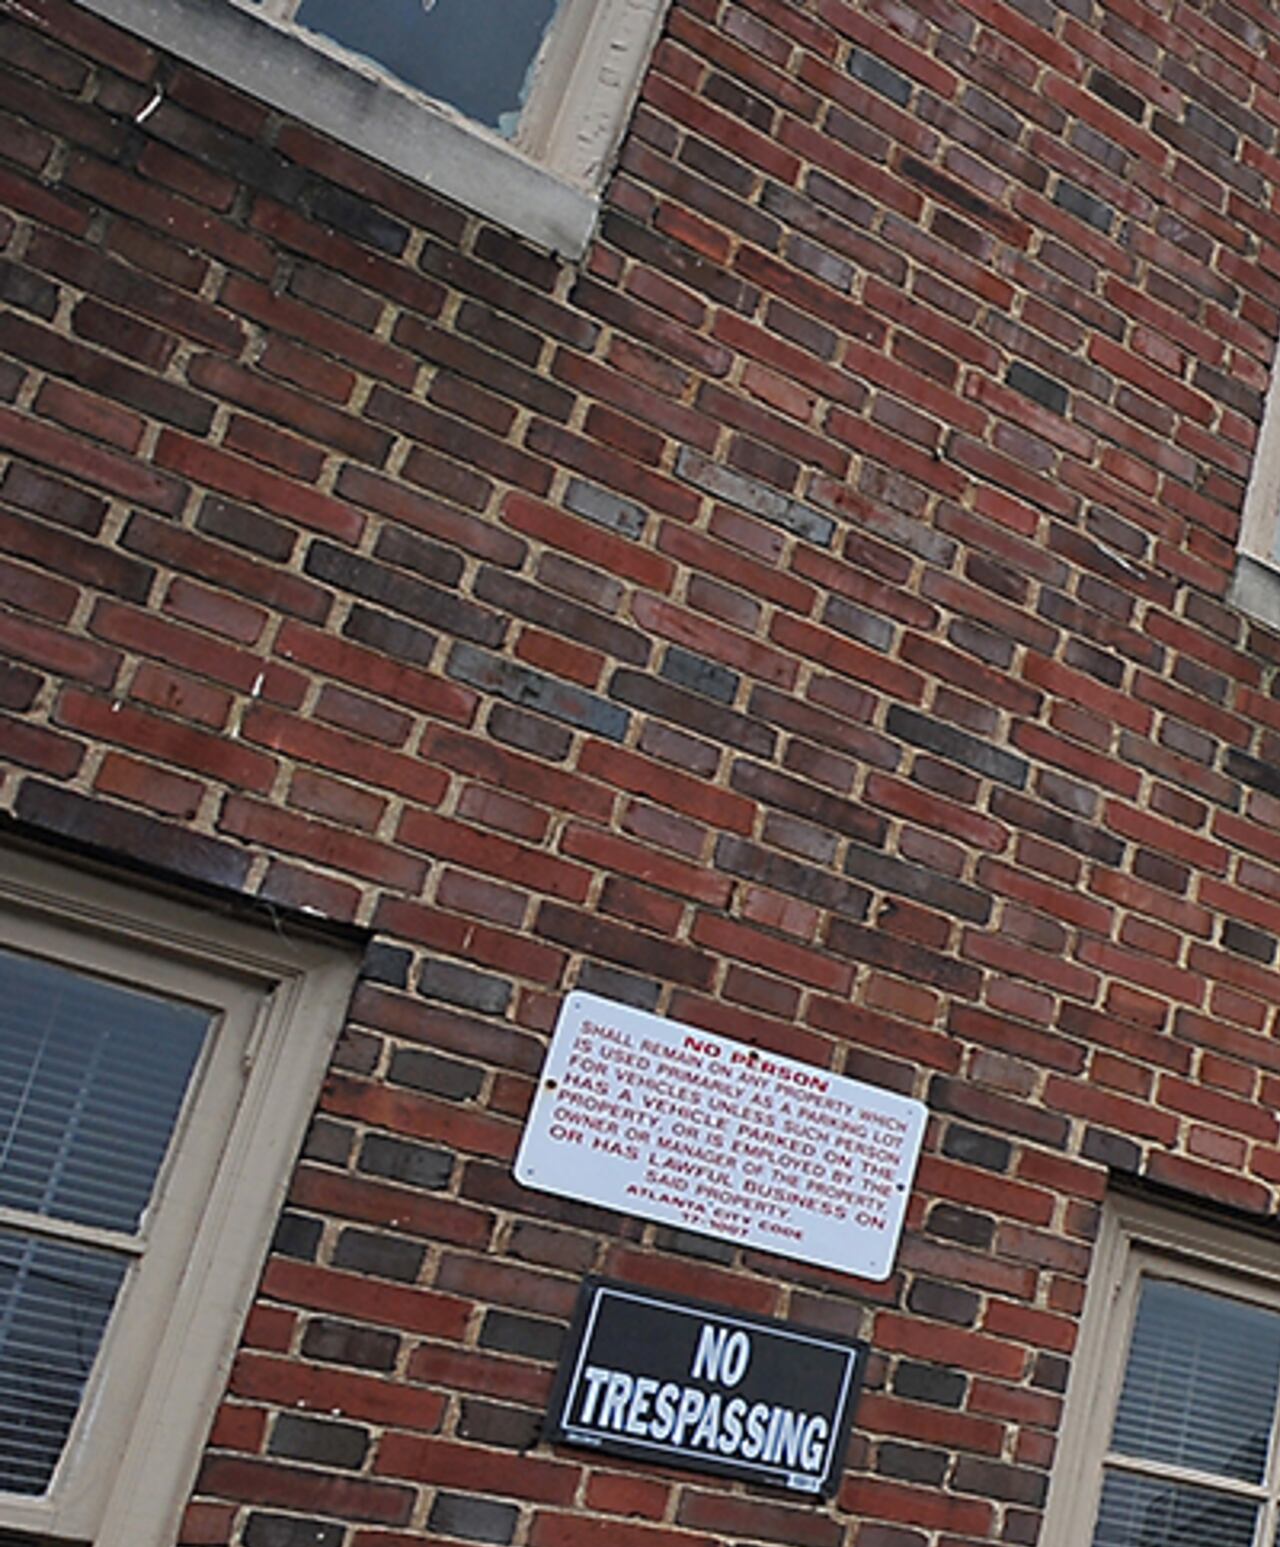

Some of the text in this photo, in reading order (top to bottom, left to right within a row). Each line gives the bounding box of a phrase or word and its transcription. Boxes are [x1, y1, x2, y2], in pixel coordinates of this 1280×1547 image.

[567, 1053, 901, 1166] FOR VEHICLES UNLESS SUCH PERSON
[572, 1036, 903, 1149] IS USED PRIMARILY AS A PARKING LOT
[580, 1020, 908, 1133] SHALL REMAIN ON ANY PROPERTY WHICH
[682, 1035, 829, 1093] NO PERSON
[552, 1105, 619, 1136] OWNER
[623, 1125, 651, 1145] OR
[656, 1135, 737, 1170] MANAGER
[741, 1159, 763, 1177] OF
[771, 1168, 799, 1187] THE
[562, 1071, 896, 1181] HAS A VEHICLE PARKED ON THE
[670, 1120, 699, 1141] OR
[705, 1131, 725, 1148] IS
[730, 1138, 827, 1178] EMPLOYED
[831, 1168, 854, 1186] BY
[861, 1177, 892, 1198] THE
[547, 1122, 886, 1231] OR HAS LAWFUL BUSINESS ON
[626, 1182, 803, 1241] ATLANTA CITY CODE
[644, 1168, 689, 1193] SAID
[692, 1325, 750, 1387] NO
[580, 1366, 828, 1470] TRESPASSING
